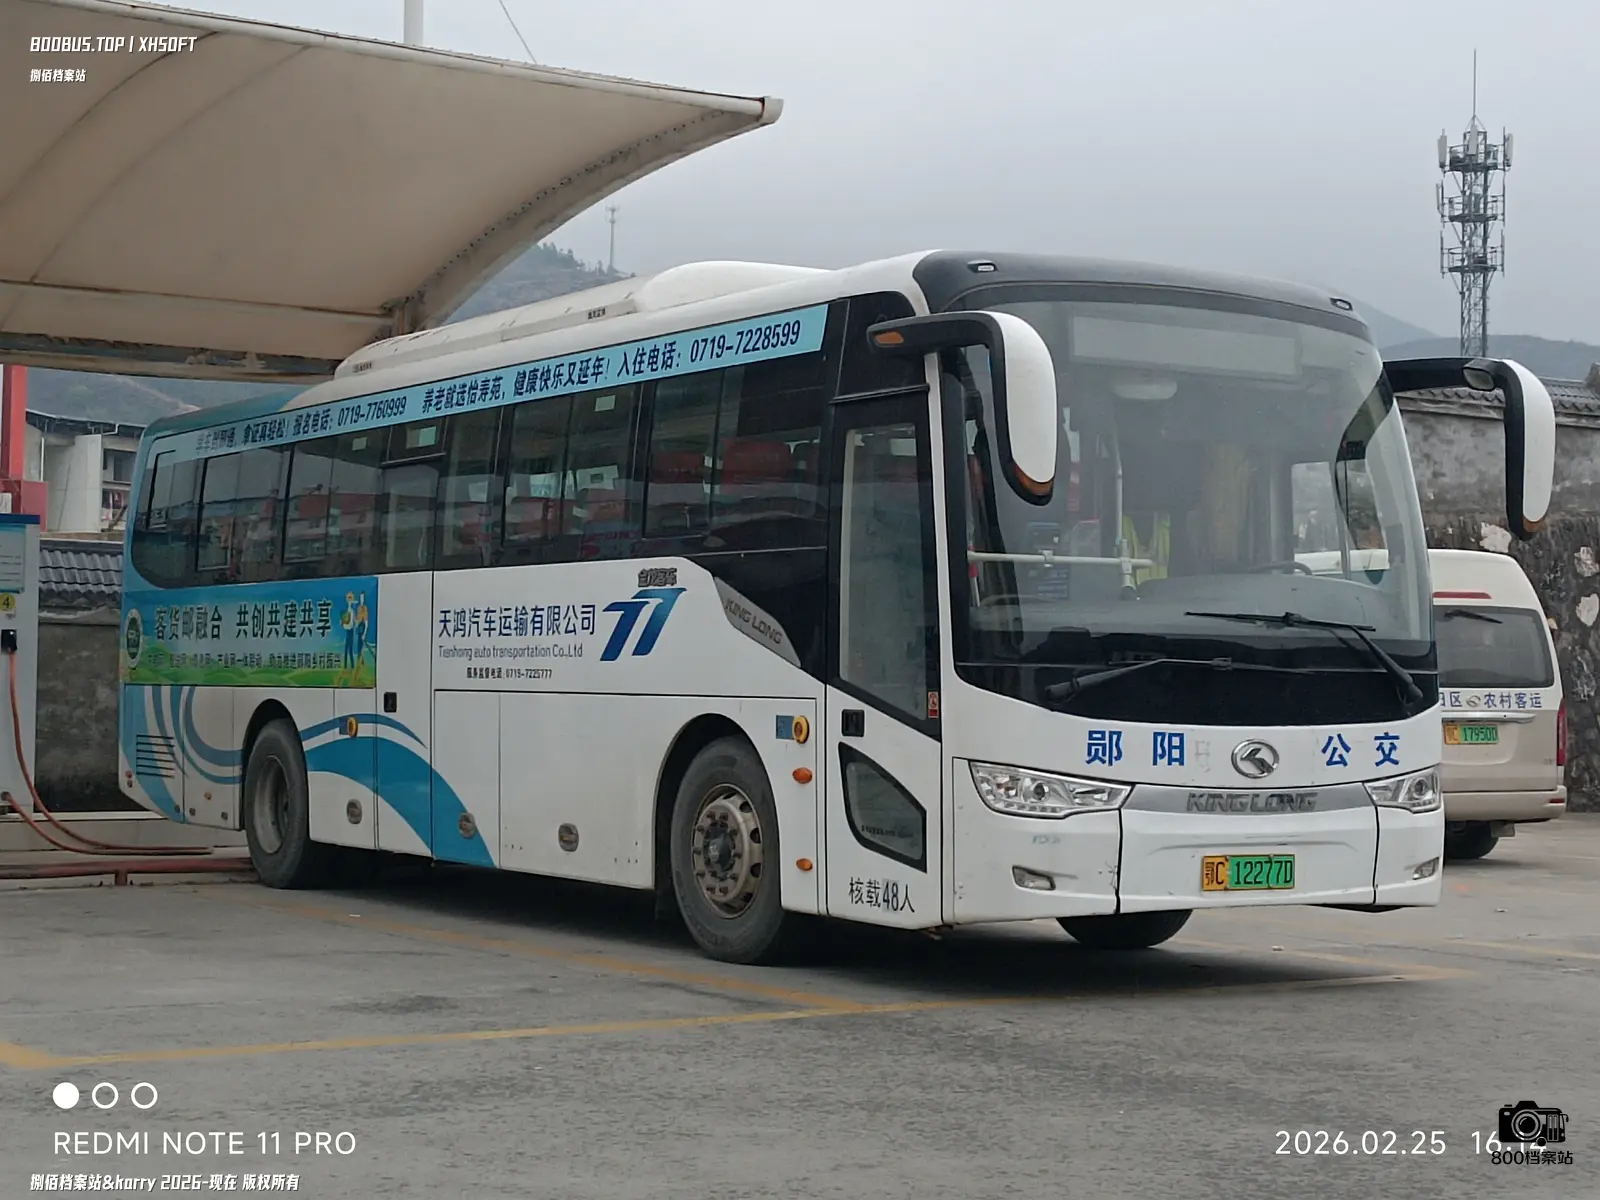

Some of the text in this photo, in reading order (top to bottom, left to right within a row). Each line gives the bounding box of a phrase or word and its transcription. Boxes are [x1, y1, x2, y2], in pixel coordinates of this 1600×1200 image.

[155, 604, 223, 641] 客货邮融合
[236, 598, 333, 640] 共创共建共享
[438, 603, 596, 638] 天鸿汽车运输有限公司
[724, 598, 783, 645] KING LONG
[474, 645, 491, 658] auto
[492, 644, 551, 660] transportation
[1484, 692, 1543, 708] 农村客运
[1085, 730, 1186, 767] 郧阳
[1321, 732, 1401, 768] 公交
[848, 876, 916, 914] 核载48人
